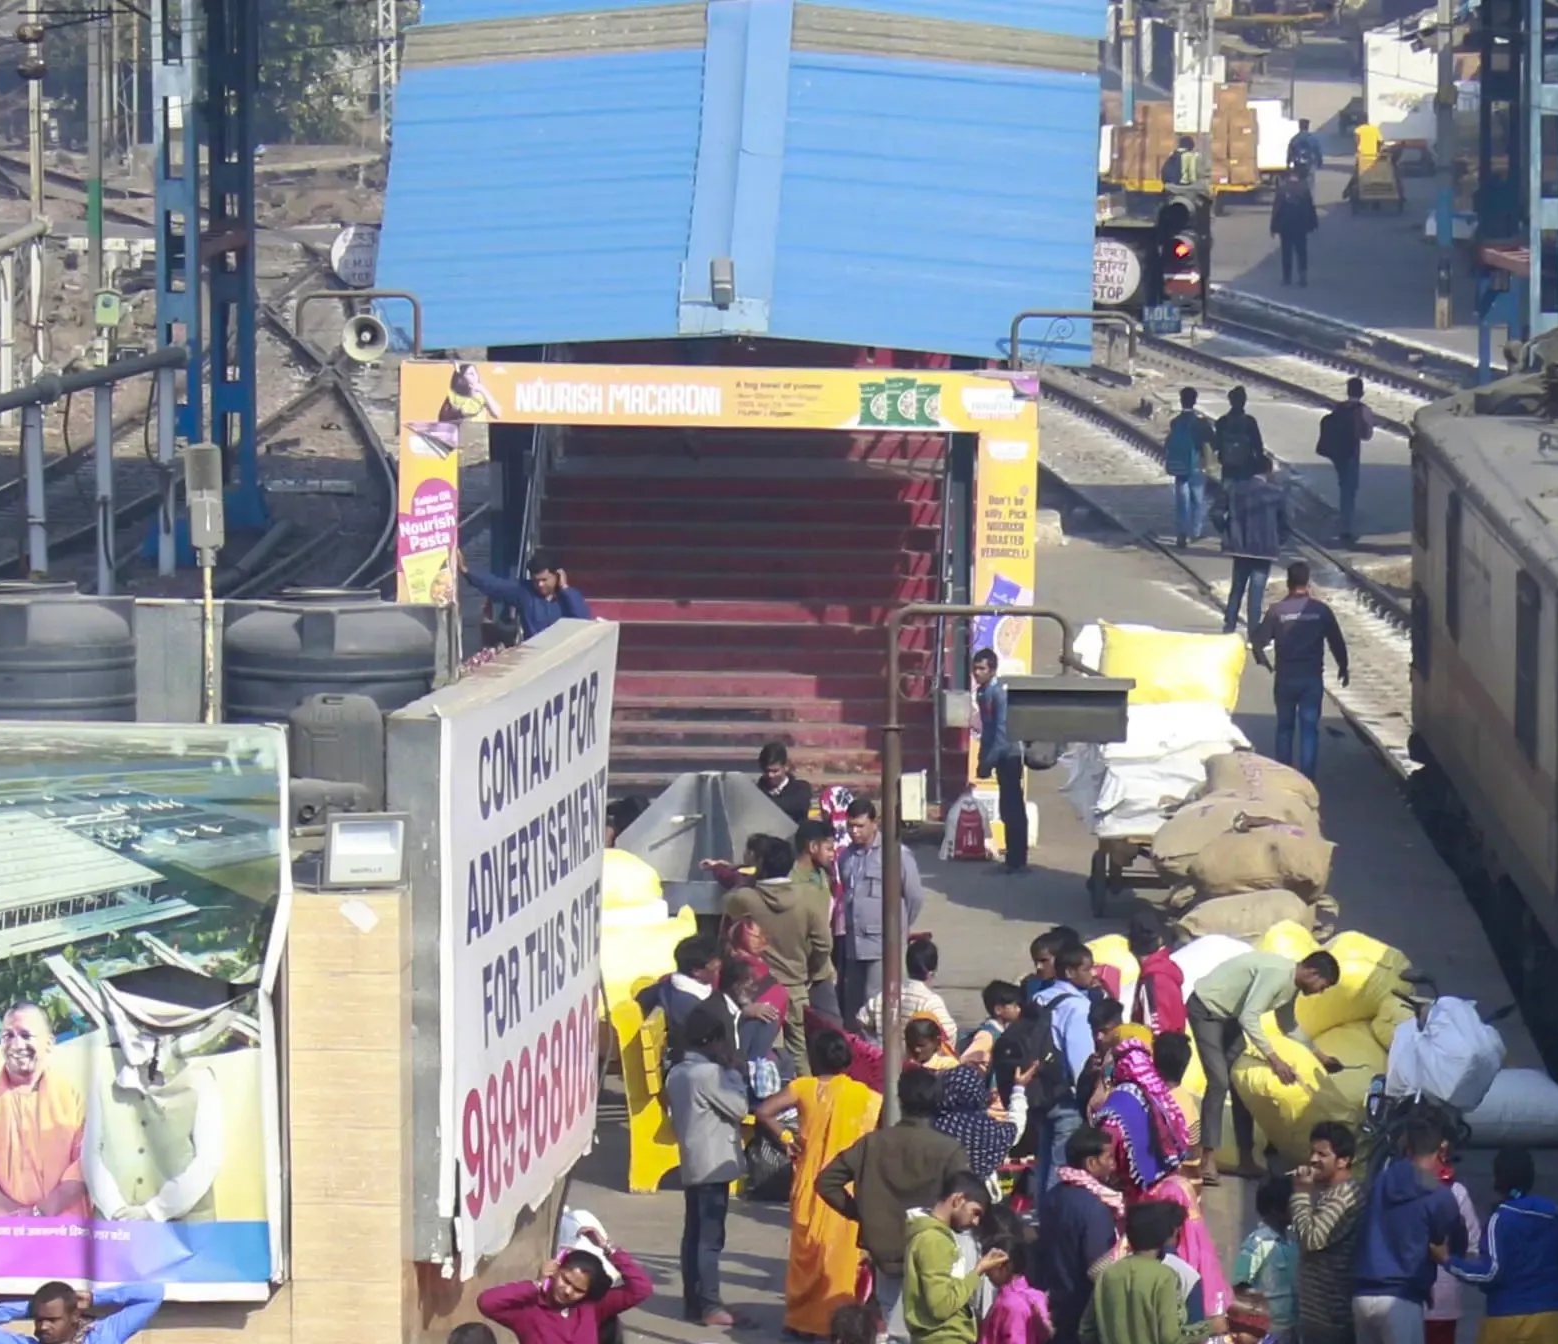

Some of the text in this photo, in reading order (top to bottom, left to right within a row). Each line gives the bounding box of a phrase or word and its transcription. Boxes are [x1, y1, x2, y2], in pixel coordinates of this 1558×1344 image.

[515, 380, 722, 416] NOURISH MACARONI
[399, 512, 456, 537] Nourish
[409, 531, 450, 551] Pasta
[479, 671, 599, 821] CONTACT FOR
[467, 765, 606, 945] ADVERTISEMENT
[482, 880, 600, 1048] FOR THIS SITE
